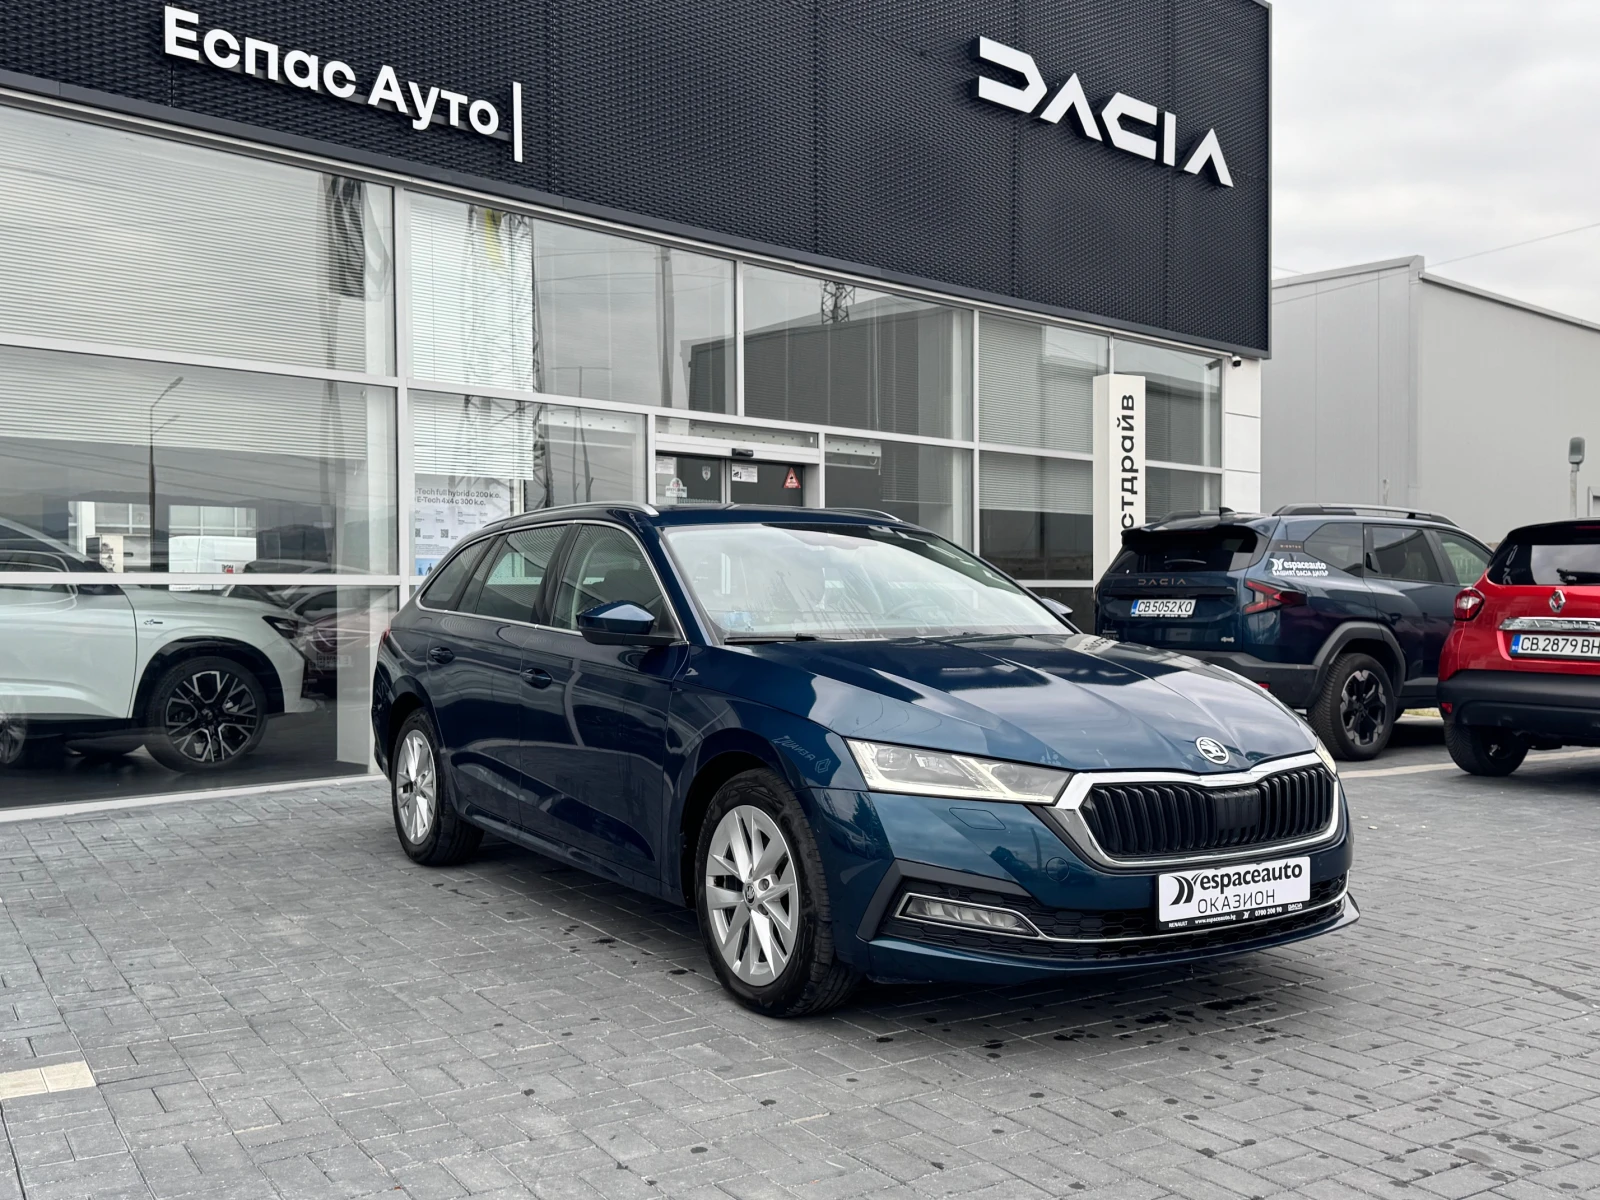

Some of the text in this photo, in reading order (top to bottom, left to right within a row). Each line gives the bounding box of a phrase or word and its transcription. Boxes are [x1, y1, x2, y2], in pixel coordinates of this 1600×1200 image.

[164, 6, 500, 136] Еспас Ауто
[978, 36, 1234, 187] DACIA
[1116, 394, 1139, 529] стдрайв
[448, 489, 470, 498] hybrid
[1283, 561, 1327, 570] espaceauto
[1137, 578, 1186, 586] DACIA
[1151, 601, 1178, 613] 5052
[1199, 861, 1303, 894] espaceauto
[1197, 889, 1276, 914] ОКАЗИОН
